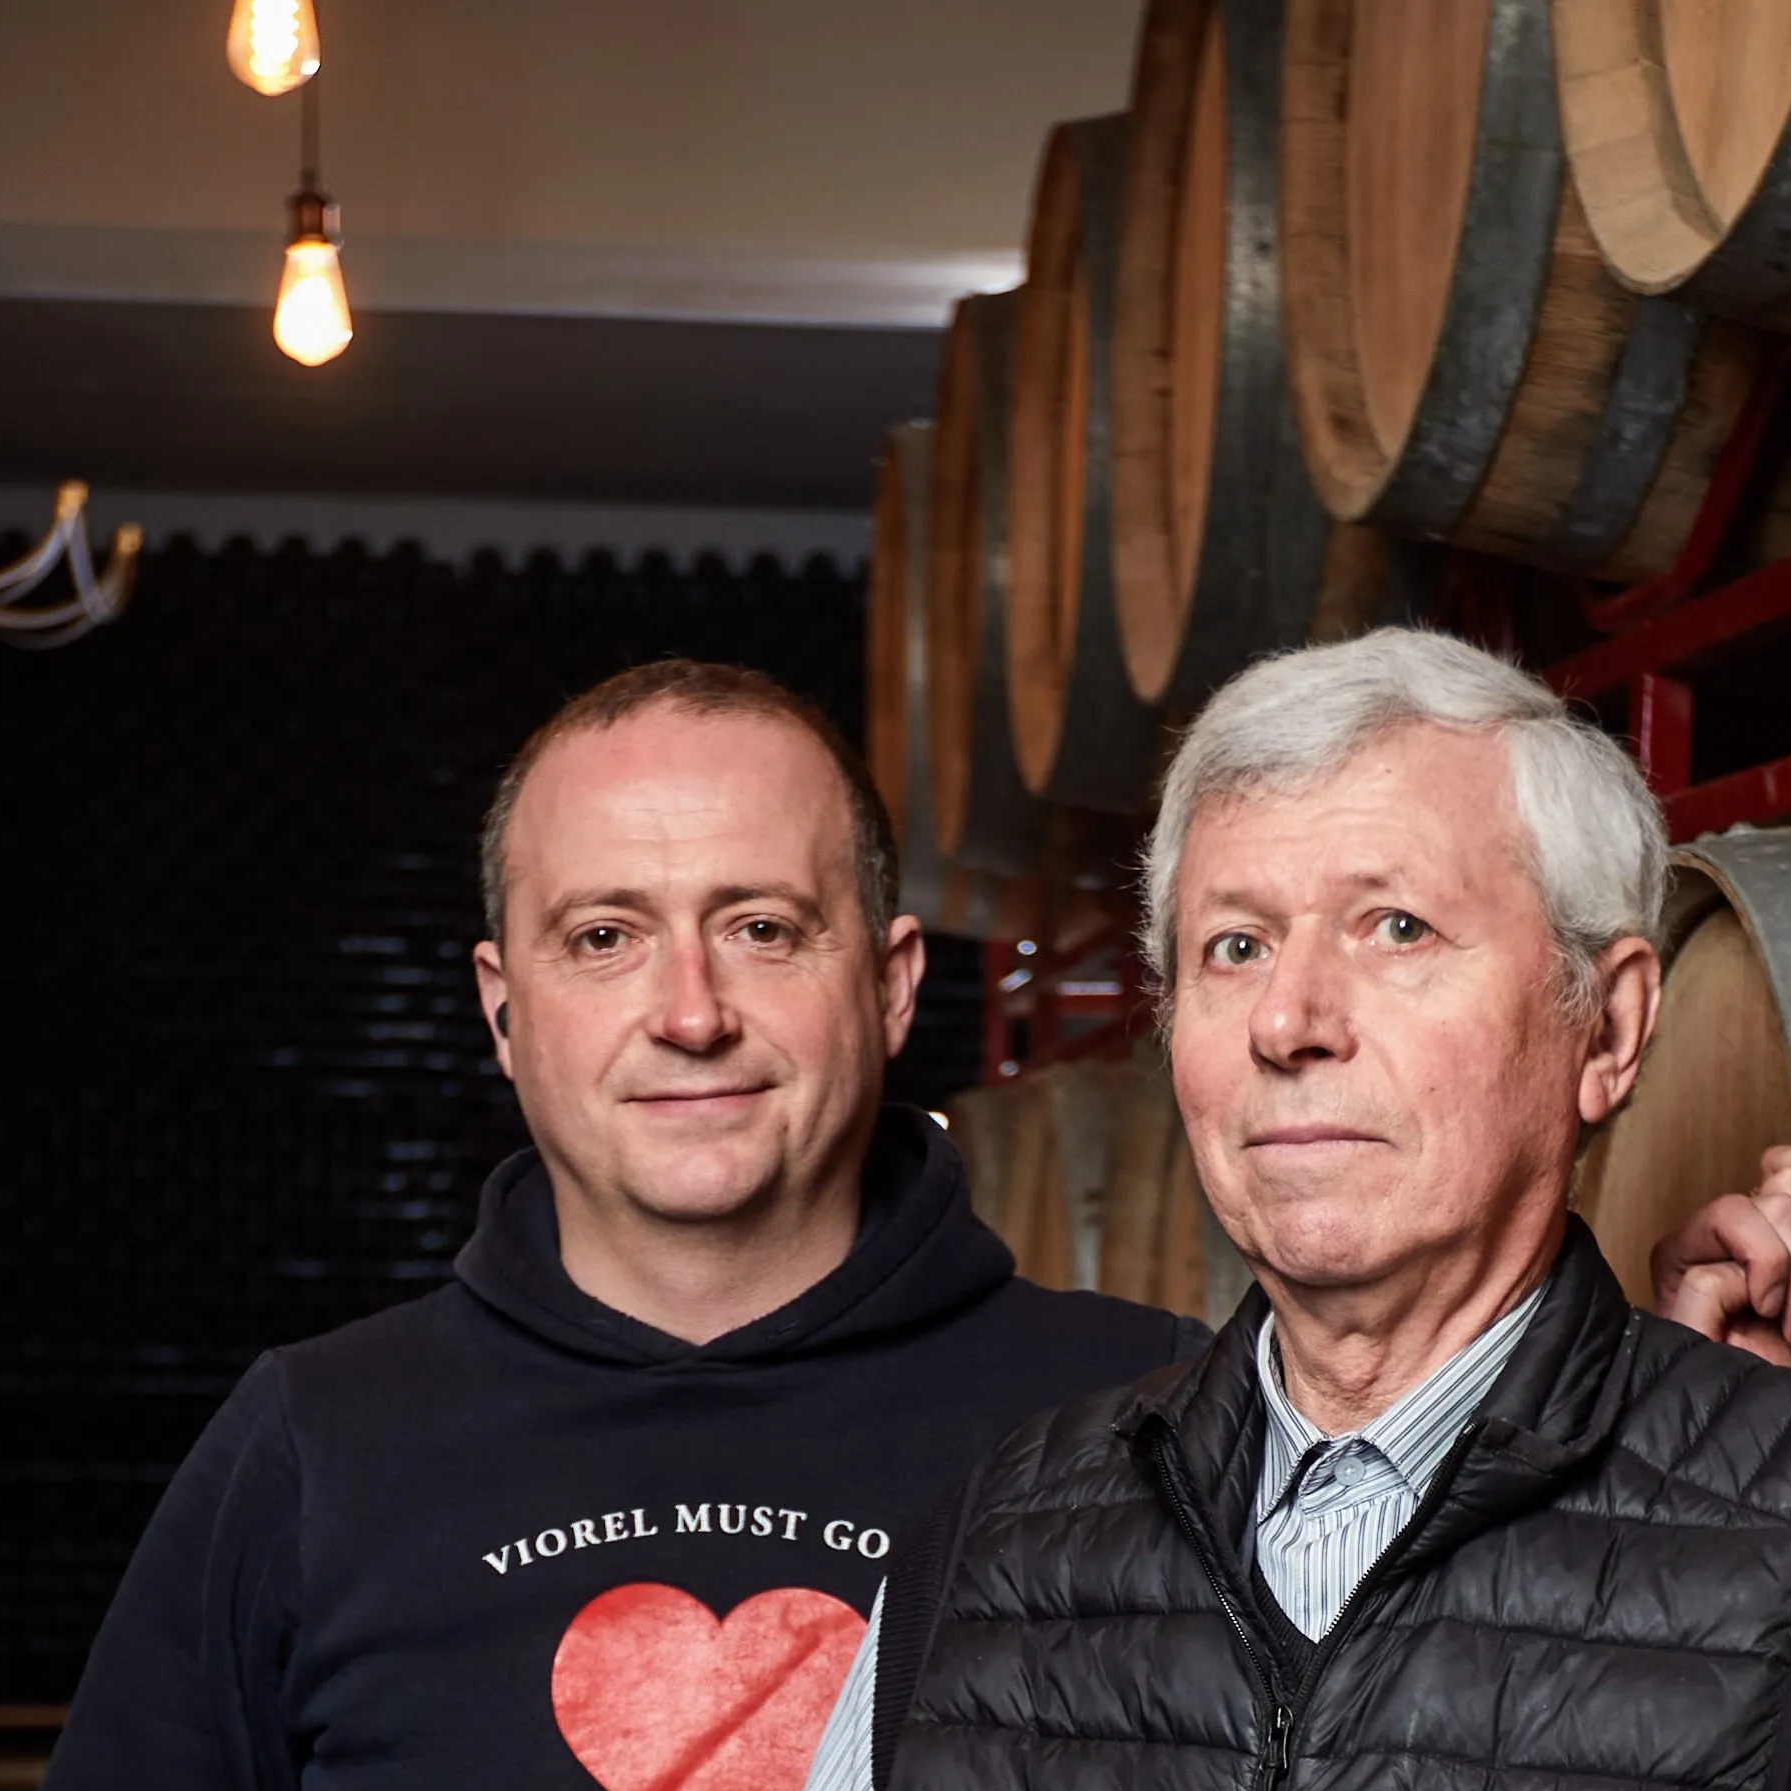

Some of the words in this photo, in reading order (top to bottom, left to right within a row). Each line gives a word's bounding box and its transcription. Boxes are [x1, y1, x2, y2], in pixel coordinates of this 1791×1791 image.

[482, 1508, 658, 1575] VIOREL
[675, 1503, 807, 1541] MUST
[823, 1520, 891, 1560] GO
